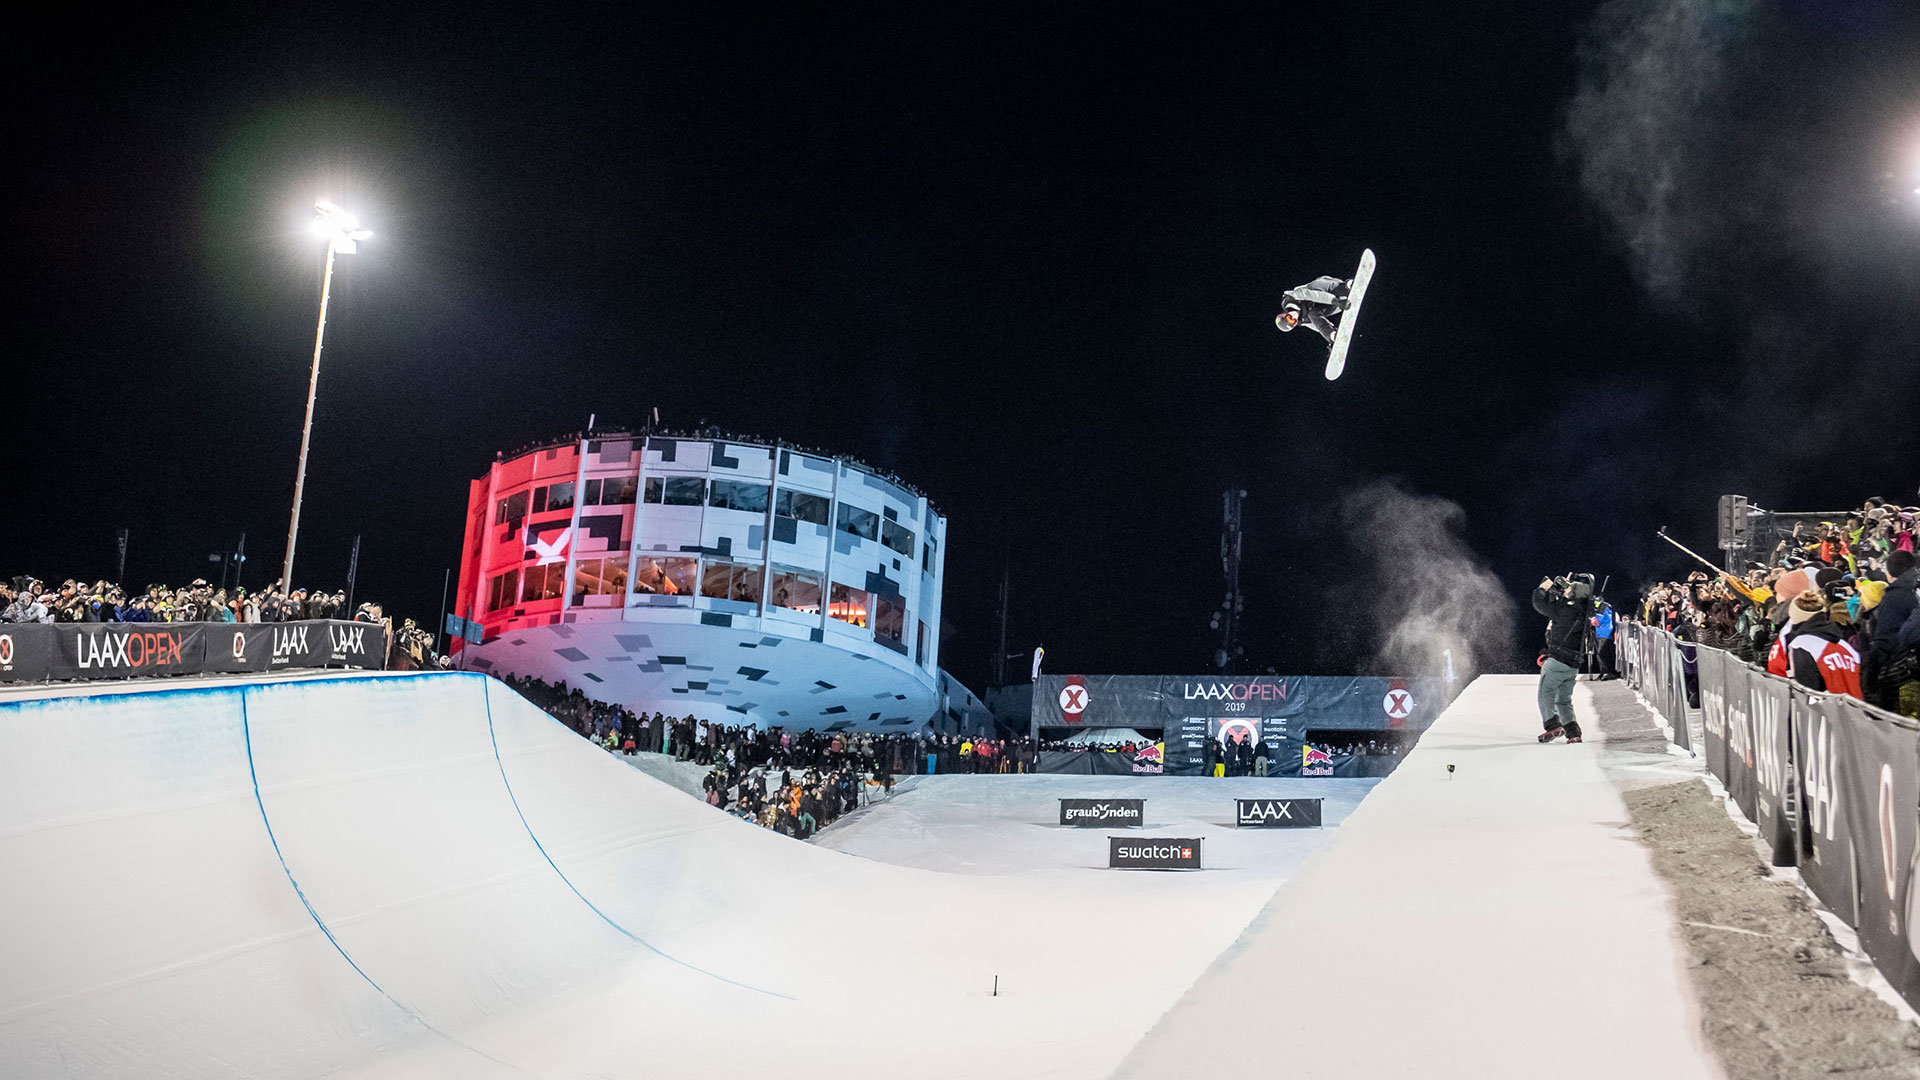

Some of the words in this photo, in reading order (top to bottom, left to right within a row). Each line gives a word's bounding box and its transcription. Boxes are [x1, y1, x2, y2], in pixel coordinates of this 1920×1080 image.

[273, 626, 309, 656] LAAX
[329, 625, 365, 655] LAAX
[1224, 702, 1246, 712] 2019
[1132, 763, 1148, 773] Red
[1148, 764, 1164, 773] Bull
[1302, 767, 1318, 776] Red
[1318, 767, 1334, 776] Bull
[1239, 801, 1293, 819] LAAX
[1118, 845, 1182, 859] swatch
